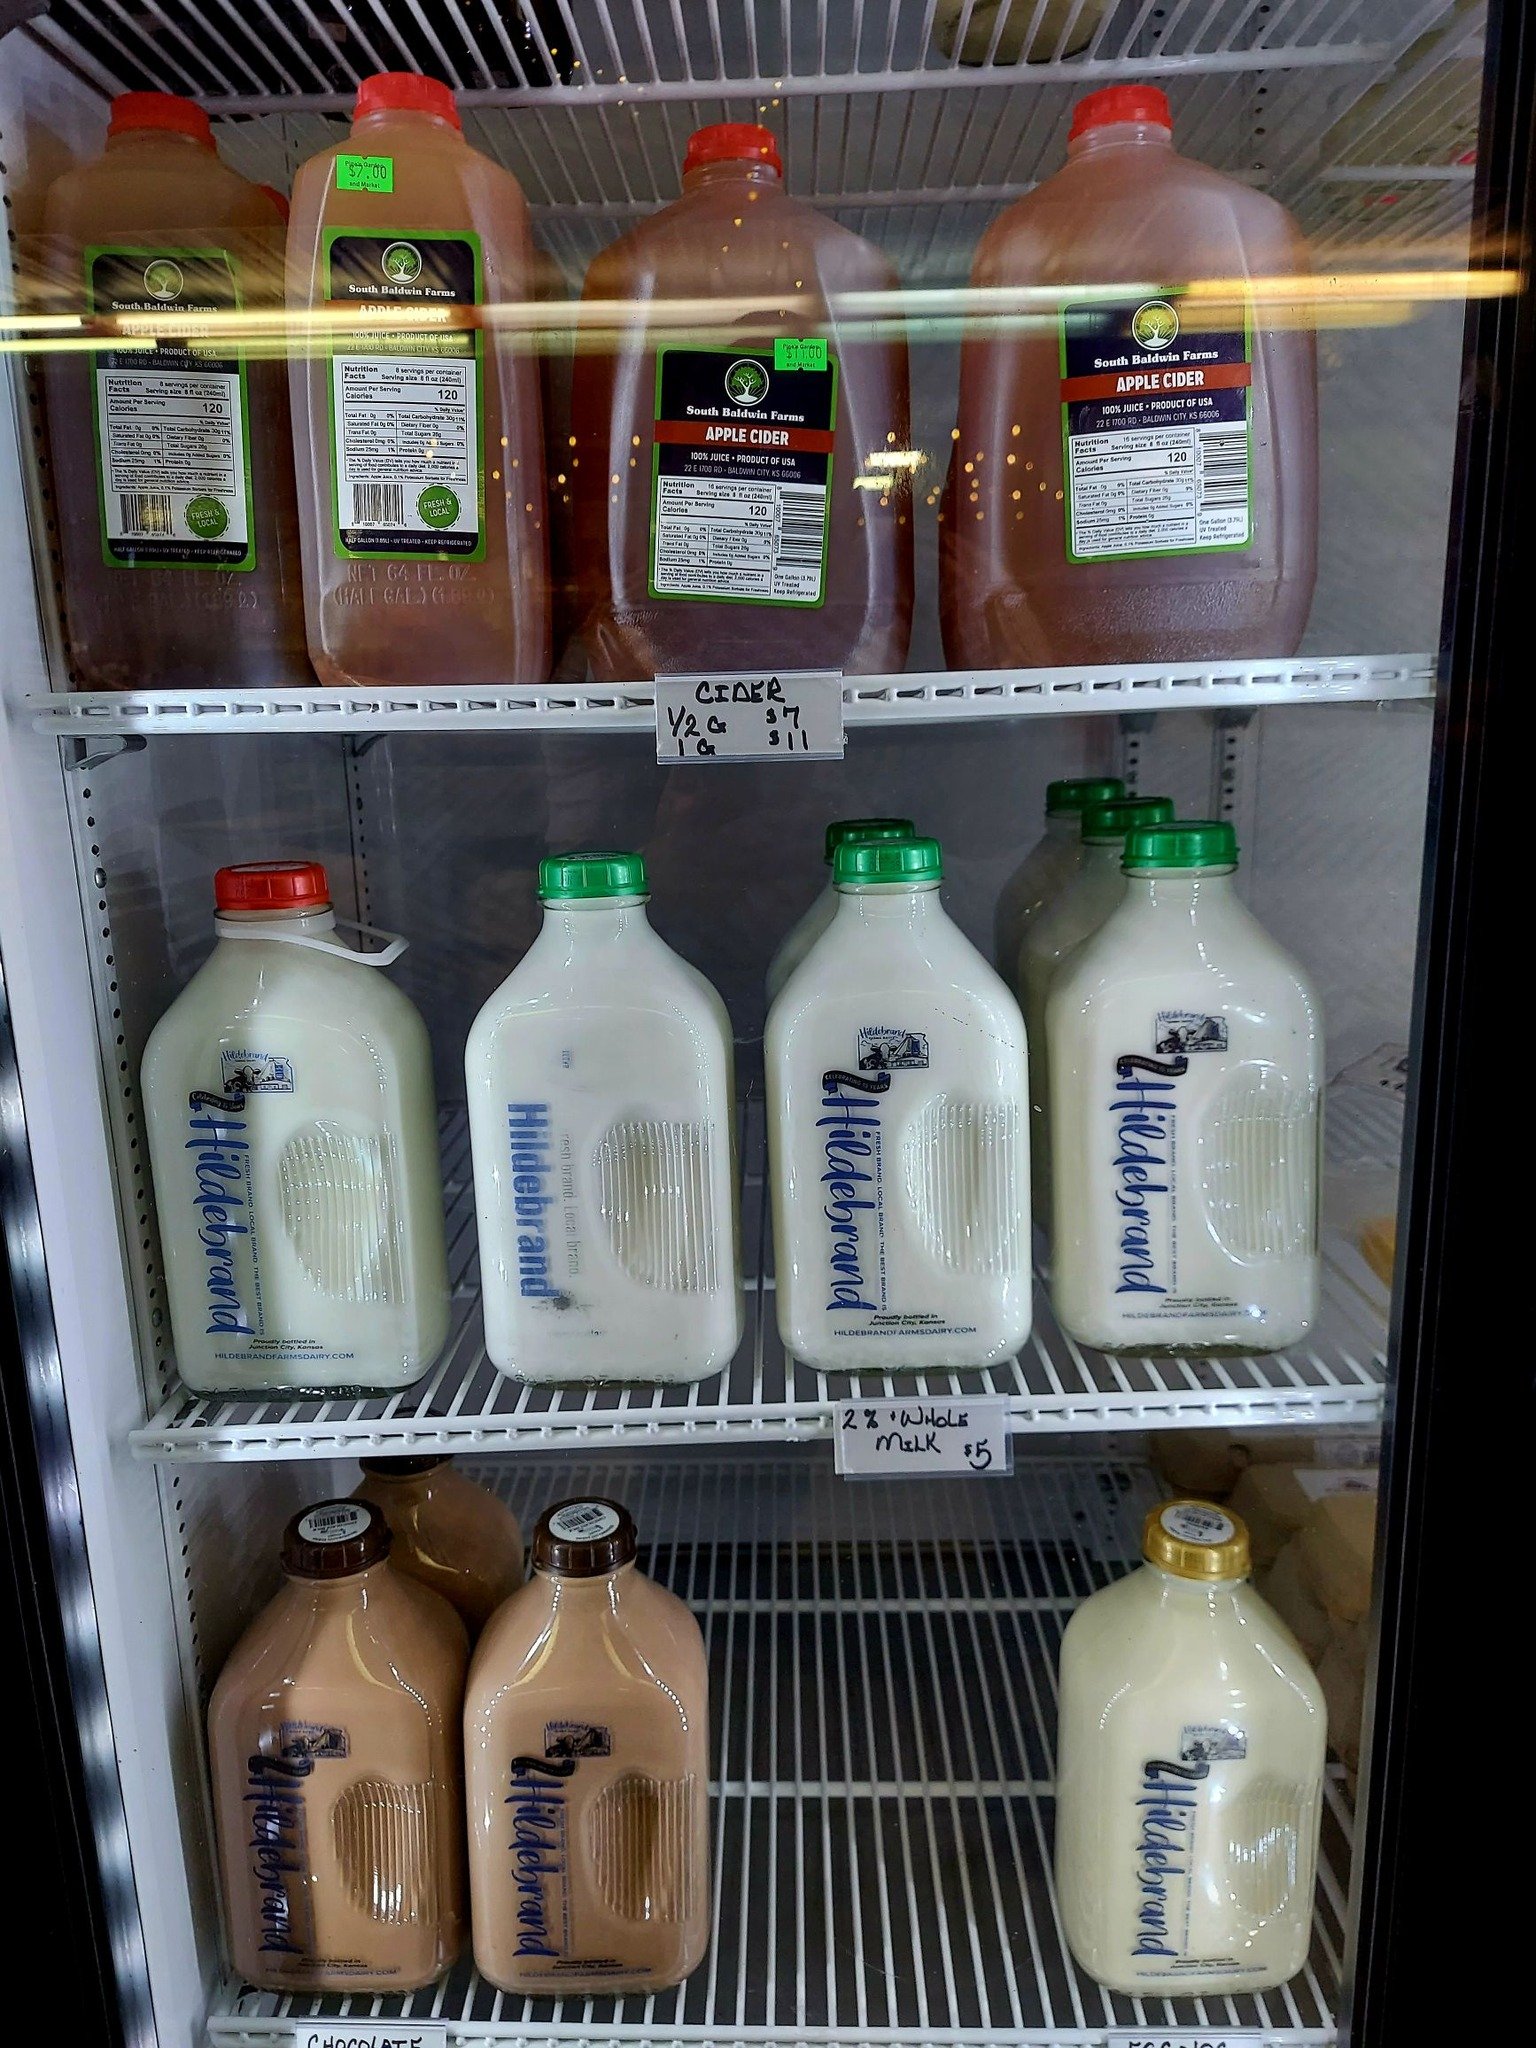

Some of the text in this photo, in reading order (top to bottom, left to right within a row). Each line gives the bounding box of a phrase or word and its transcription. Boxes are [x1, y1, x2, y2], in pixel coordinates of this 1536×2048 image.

[349, 164, 387, 179] $7.00
[348, 285, 456, 297] South Baldwin Farms
[111, 301, 218, 313] South Baldwin Farms
[160, 348, 191, 356] PRODUCT
[786, 347, 822, 359] $11.00
[1094, 350, 1219, 368] South Baldwin Farms
[1116, 370, 1205, 392] APPLE CIDER
[438, 390, 458, 400] 120
[202, 403, 223, 414] 120
[1102, 397, 1213, 414] 100% JUICE PRODUCT OF USA
[686, 406, 805, 422] South Baldwin Farms
[1106, 419, 1110, 427] E
[1142, 414, 1171, 424] BALDWIN
[1189, 411, 1198, 420] KS
[1199, 410, 1220, 419] 66006
[705, 426, 789, 446] APPLE CIDER
[1075, 438, 1109, 446] Nutrition
[691, 452, 796, 466] 100% JUICE PRODUCT OF USA
[1110, 455, 1131, 463] Serving
[1167, 452, 1187, 462] 120
[684, 464, 692, 472] 22
[693, 464, 697, 472] E
[727, 467, 755, 476] BALDWIN
[663, 481, 695, 489] Nutrition
[423, 500, 445, 509] FRESH
[749, 505, 767, 516] 120
[192, 511, 213, 520] FRESH
[429, 509, 450, 517] LOCAL
[197, 519, 219, 528] LOCAL
[696, 676, 785, 703] CIDER
[667, 705, 800, 737] 1/2 G $7
[678, 729, 808, 756] 1 G $11
[860, 1026, 906, 1039] Hildebrand
[1109, 1077, 1177, 1293] Hildebrand
[507, 1103, 560, 1297] Hildebrand
[815, 1092, 881, 1311] Hildebrand
[185, 1114, 255, 1335] Hildebrand
[215, 1352, 354, 1360] HILDEBRANDFARMSDAIRY.COM
[900, 1405, 969, 1428] WHOLE
[875, 1431, 992, 1470] MILK $5
[242, 1777, 307, 1955] Hildebrand
[504, 1776, 565, 1957] Hildebrand
[1131, 1780, 1198, 1957] Hildebrand
